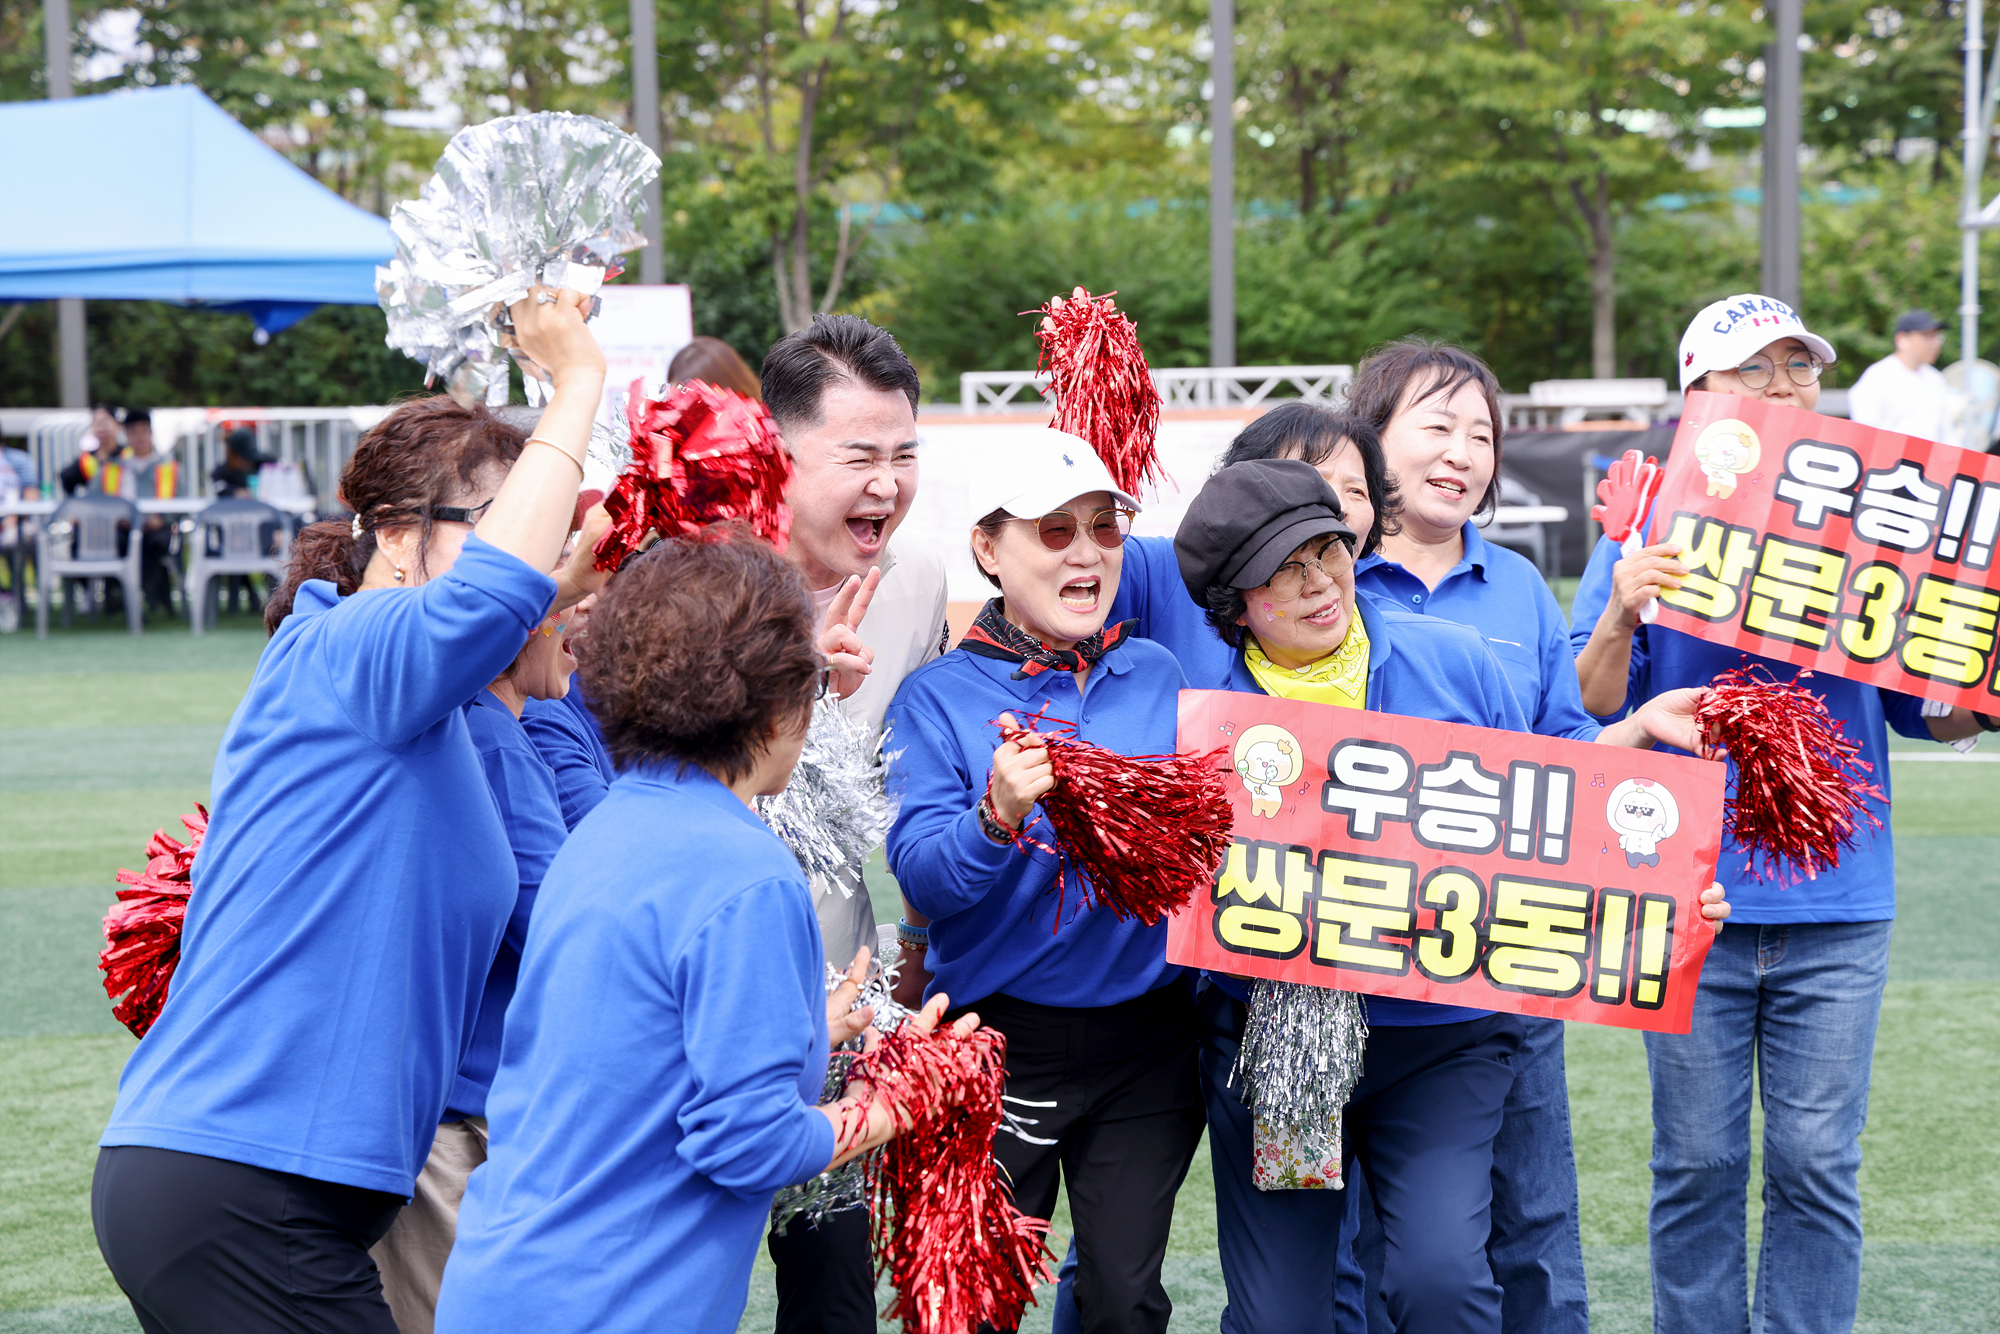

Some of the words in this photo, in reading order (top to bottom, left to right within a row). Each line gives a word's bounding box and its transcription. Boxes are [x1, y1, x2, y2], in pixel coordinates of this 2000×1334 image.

[1713, 298, 1800, 335] CANADA
[1775, 439, 2000, 570] 우승!!
[1658, 511, 2000, 695] 쌍문3동
[1323, 739, 1576, 865] 우승!!
[1212, 836, 1676, 1010] 쌍문3동!!
